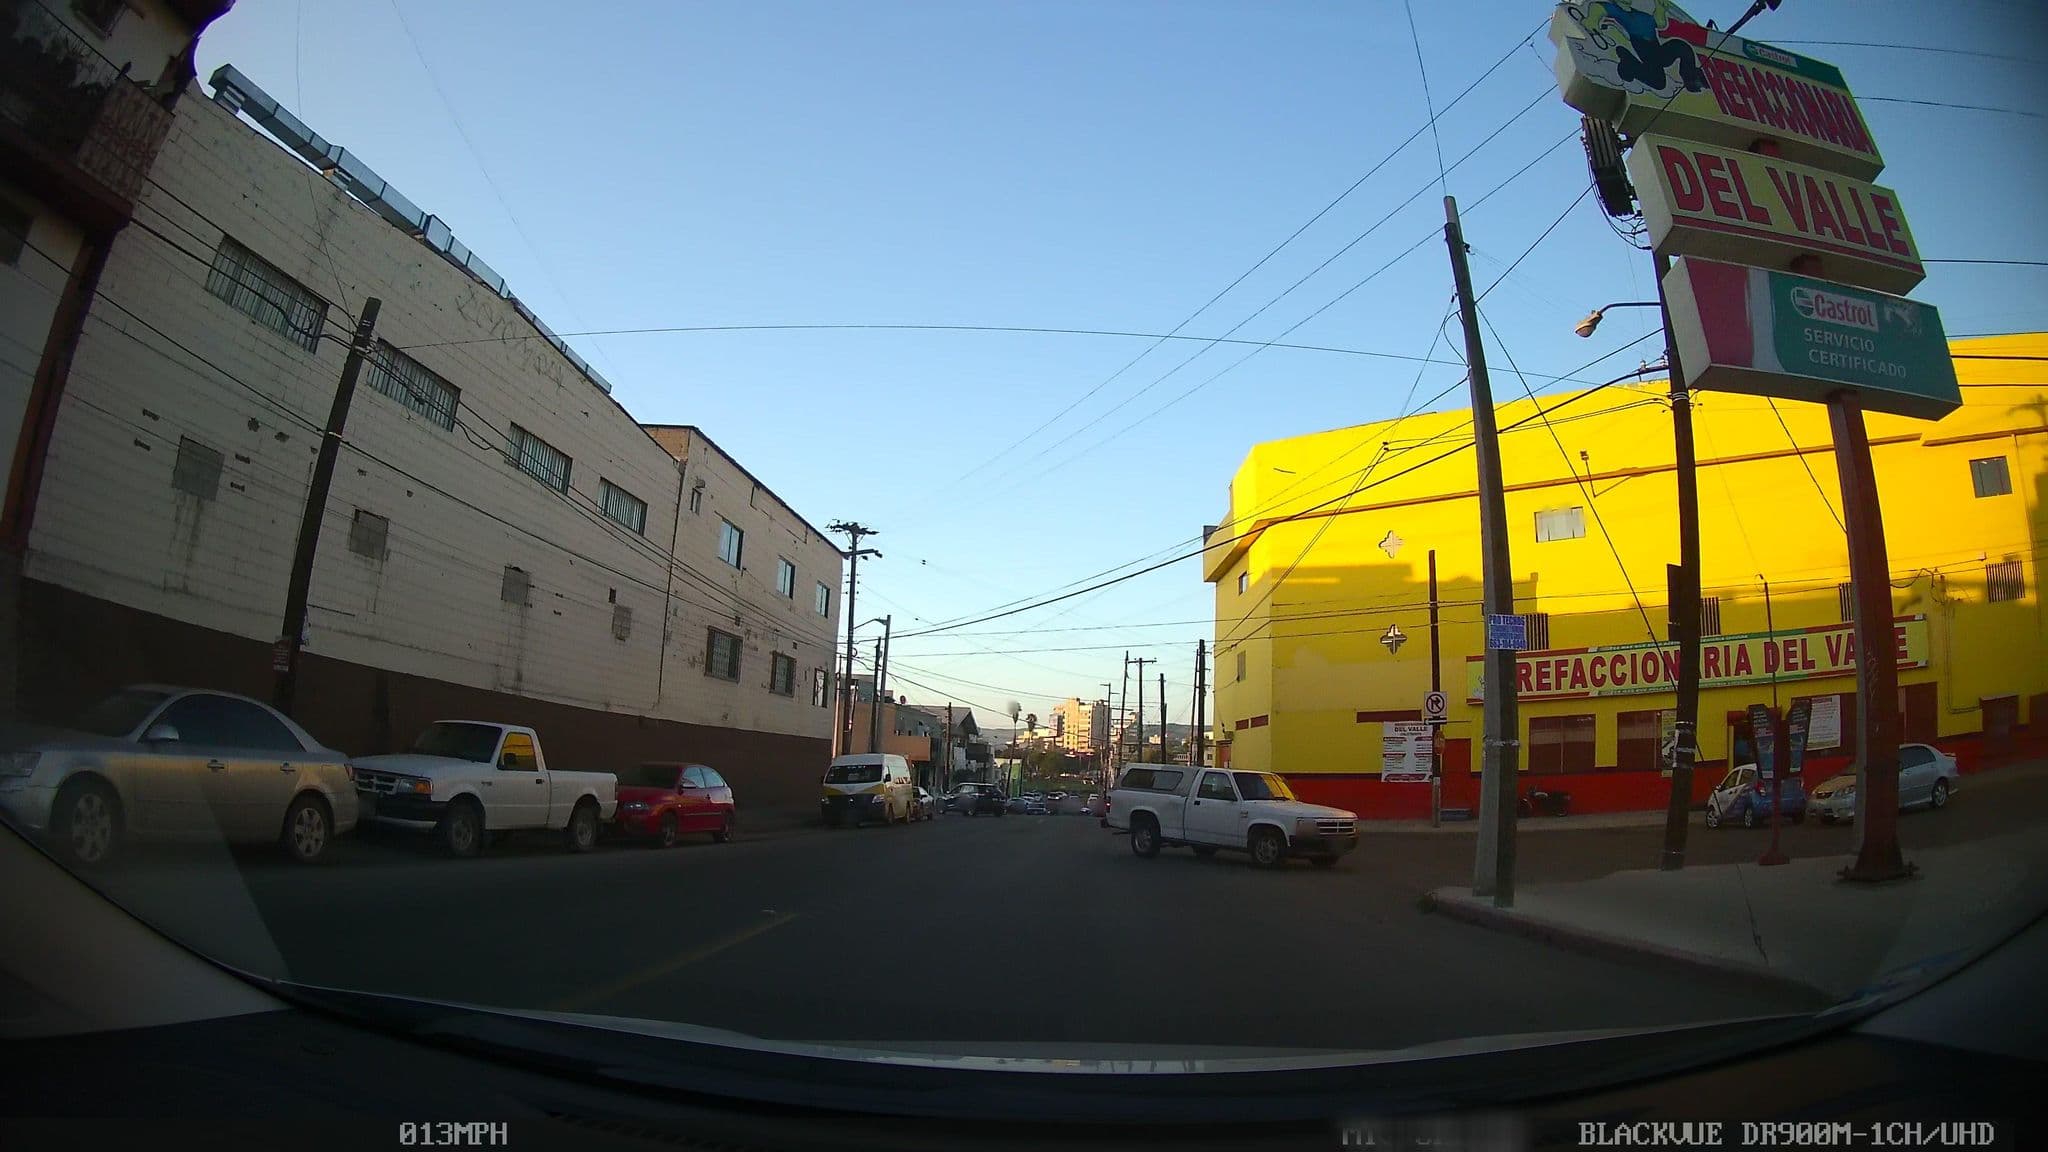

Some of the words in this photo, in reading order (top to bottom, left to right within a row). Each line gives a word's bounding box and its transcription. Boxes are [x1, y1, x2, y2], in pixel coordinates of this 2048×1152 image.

[1658, 145, 1773, 227] DEL
[1765, 166, 1912, 258] VALLE
[1813, 294, 1876, 328] Castrol
[1804, 327, 1875, 353] SERVICIO
[1808, 348, 1907, 379] CERTIFICADO
[1516, 643, 1752, 693] REFACCIONRIA
[1763, 637, 1816, 674] DEL
[1825, 626, 1908, 667] VAE
